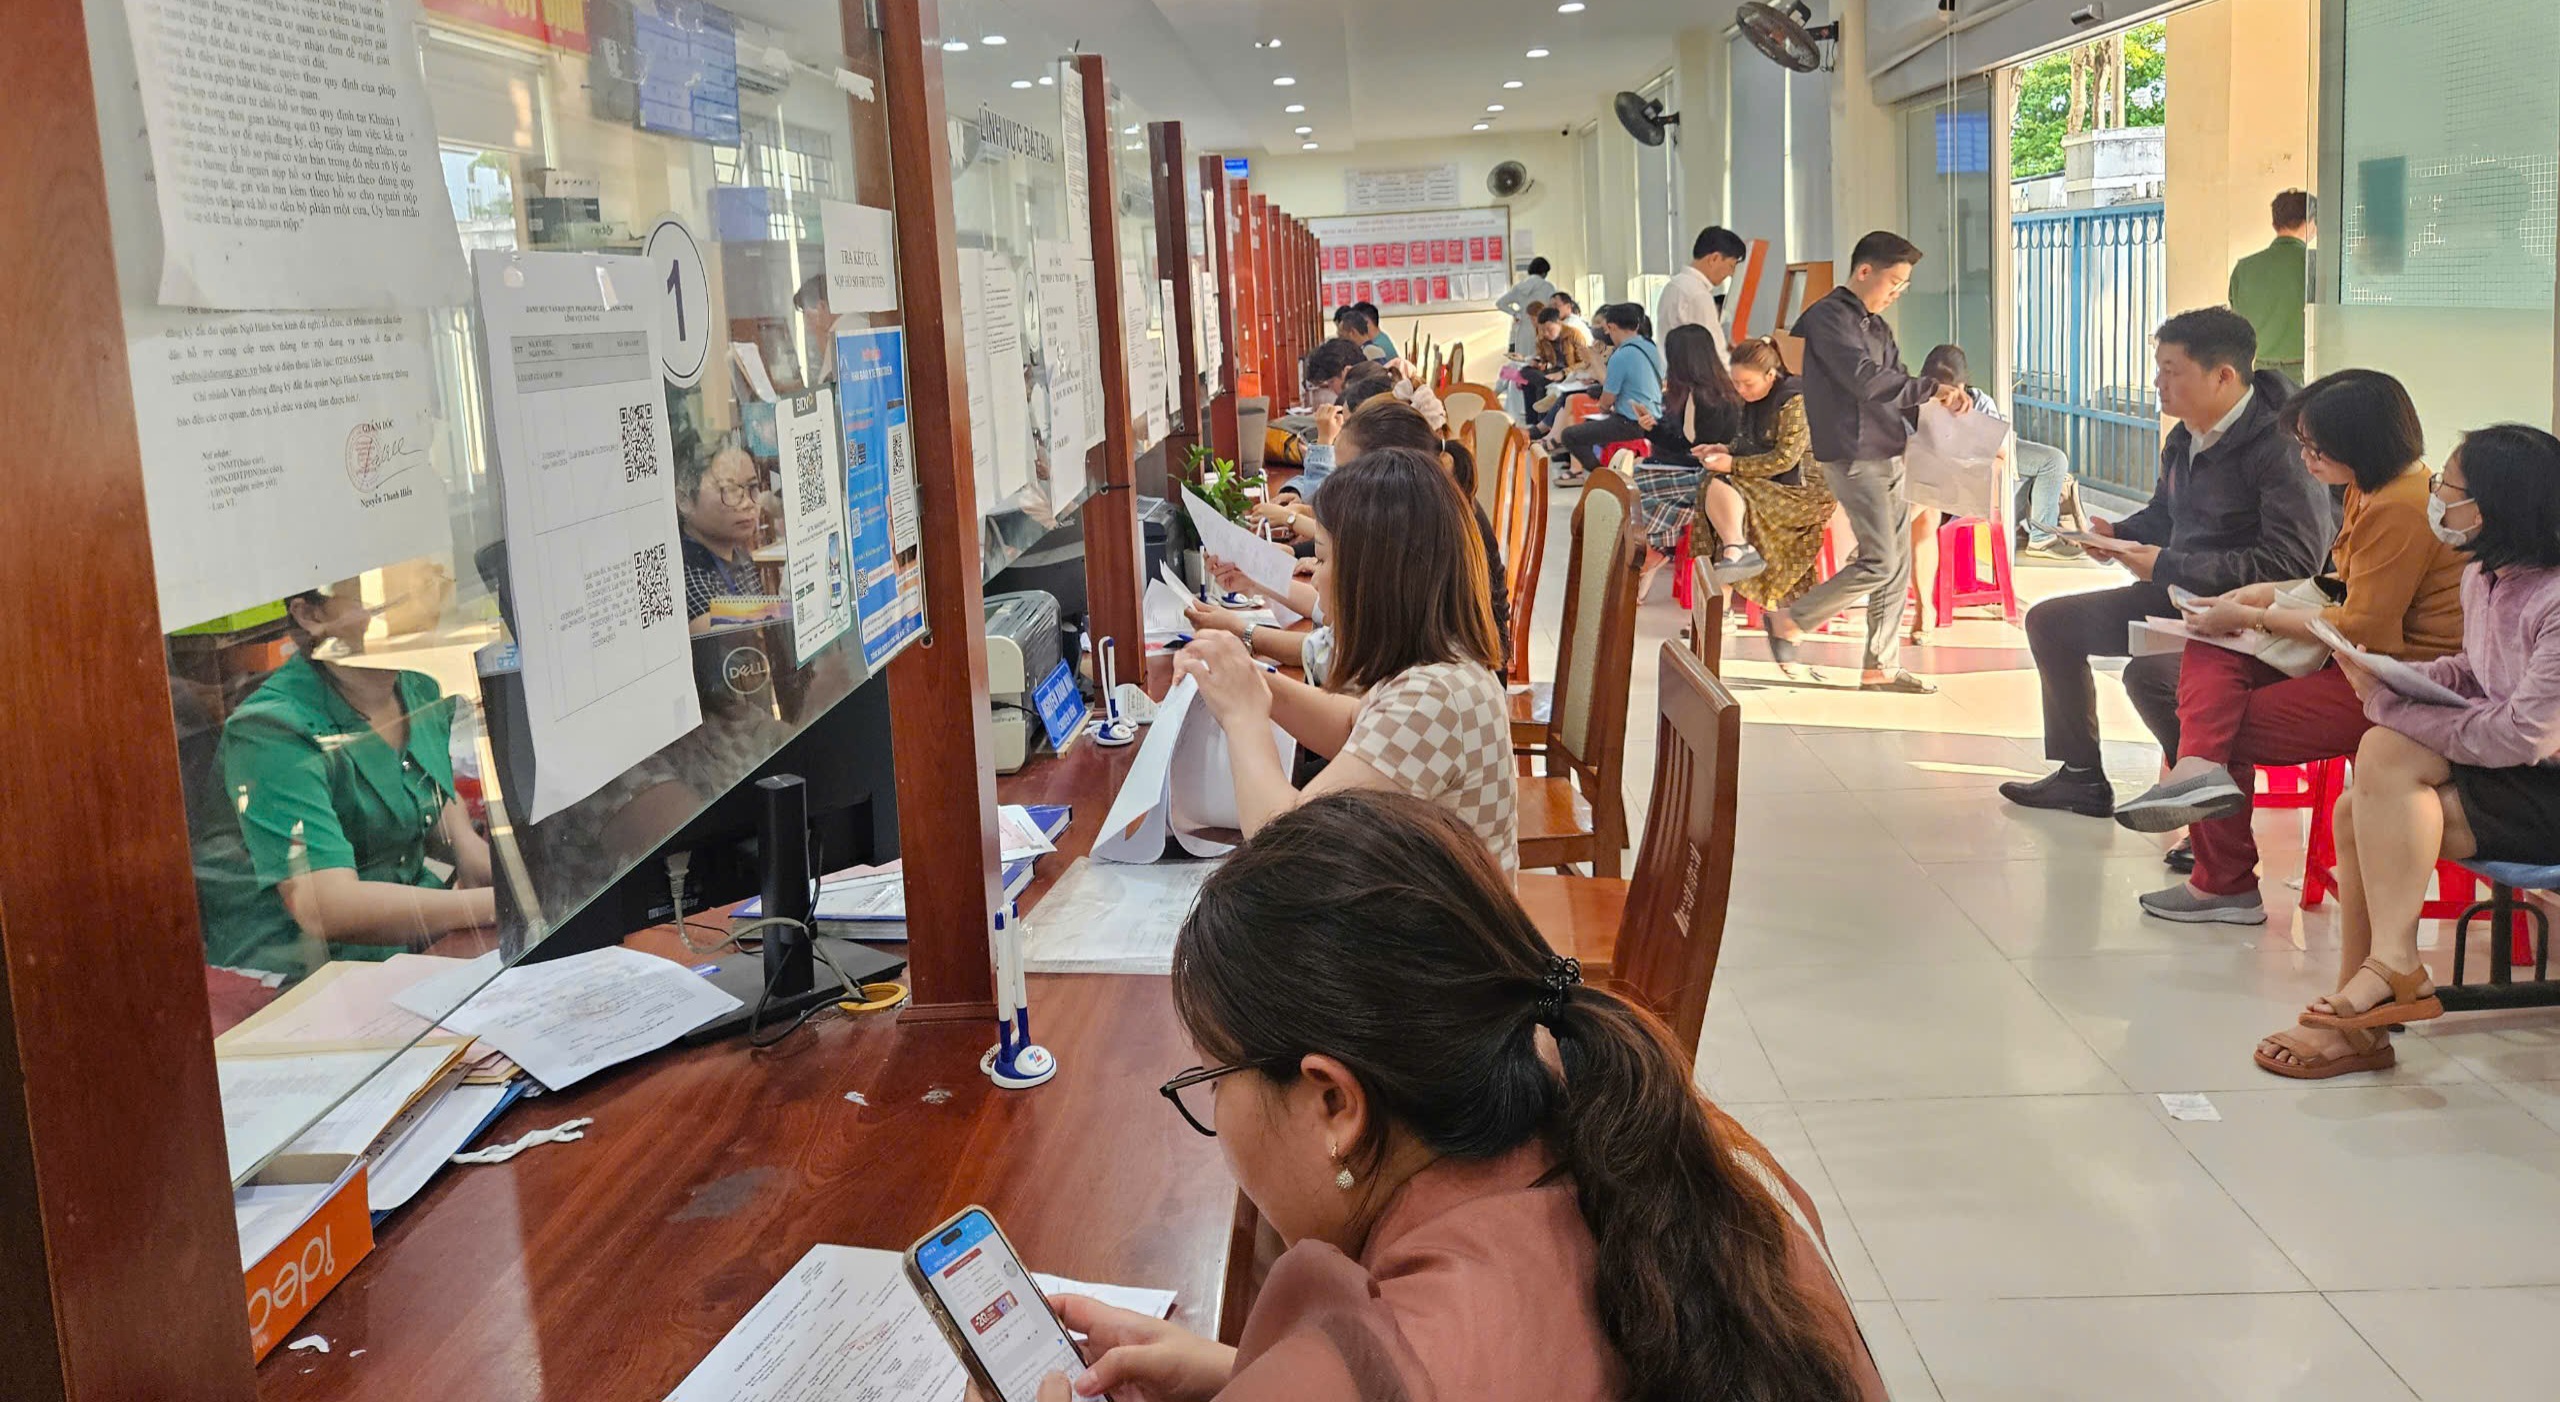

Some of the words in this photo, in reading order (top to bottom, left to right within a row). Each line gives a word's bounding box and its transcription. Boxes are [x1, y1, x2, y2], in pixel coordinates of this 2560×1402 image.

[979, 101, 1003, 147] LĨNH
[1002, 116, 1022, 160] VỰC
[667, 259, 686, 341] 1
[1028, 290, 1036, 330] 2
[729, 662, 767, 680] DELL
